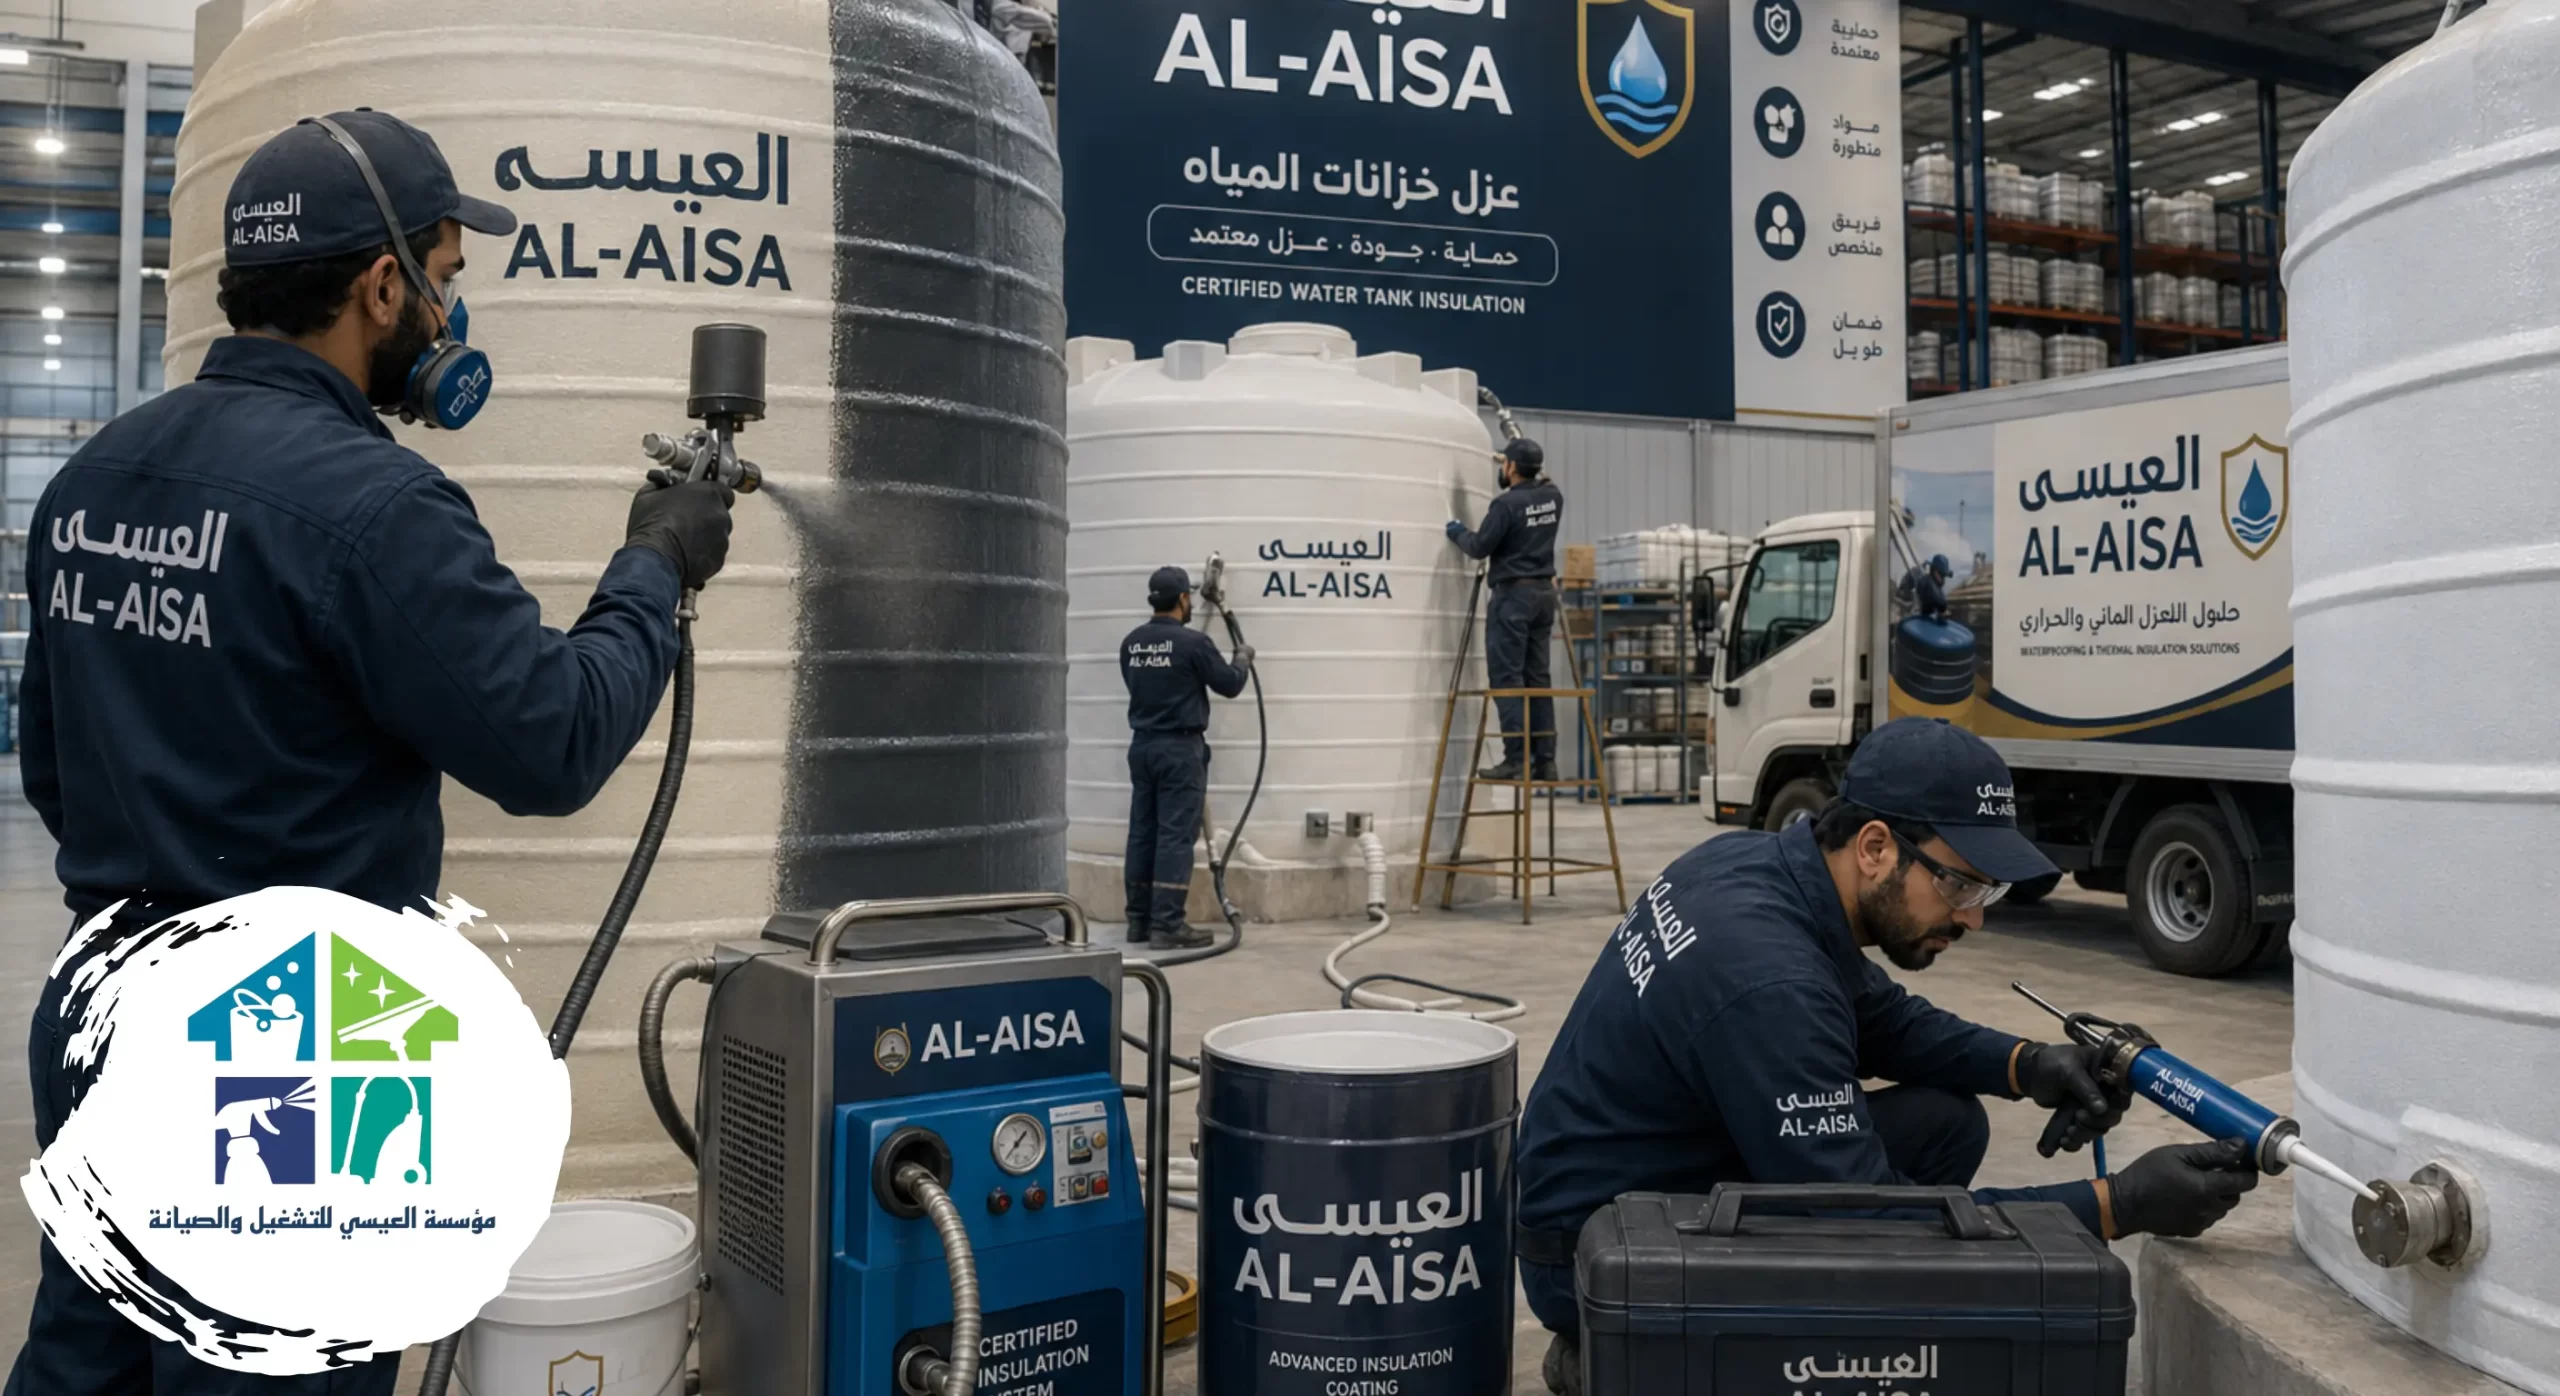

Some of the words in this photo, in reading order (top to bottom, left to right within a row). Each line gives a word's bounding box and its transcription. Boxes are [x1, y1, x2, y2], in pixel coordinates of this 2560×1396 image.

[1154, 12, 1512, 115] AL-AISA
[1183, 146, 1299, 198] المياه
[1313, 158, 1439, 210] خزانات
[1452, 170, 1520, 216] عزل
[232, 223, 301, 246] AL-AISA
[1190, 225, 1260, 248] معتمد
[1268, 228, 1328, 257] عزل
[1350, 234, 1424, 263] جودة
[1444, 242, 1519, 268] حماية
[504, 223, 792, 291] AL-AISA
[1182, 277, 1282, 299] CERTIFIED
[1290, 282, 1358, 304] WATER
[1364, 287, 1413, 308] TANK
[1419, 291, 1525, 314] INSULATION
[2019, 434, 2200, 512] العيسى
[52, 509, 229, 578] العيسى
[1259, 530, 1390, 566] العيسى
[2019, 514, 2203, 577] AL-AISA
[1262, 571, 1392, 599] AL-AISA
[49, 569, 211, 648] AL-AISA
[920, 1009, 1085, 1062] AL-AISA
[1779, 1113, 1859, 1136] AL-AISA
[1233, 1167, 1482, 1248] العيسى
[1234, 1244, 1482, 1305] AL-AISA
[979, 1318, 1078, 1357] CERTIFIED
[978, 1344, 1089, 1388] INSULATION
[1269, 1350, 1358, 1373] ADVANCED
[1362, 1347, 1453, 1373] INSULATION
[1325, 1380, 1399, 1396] COATING
